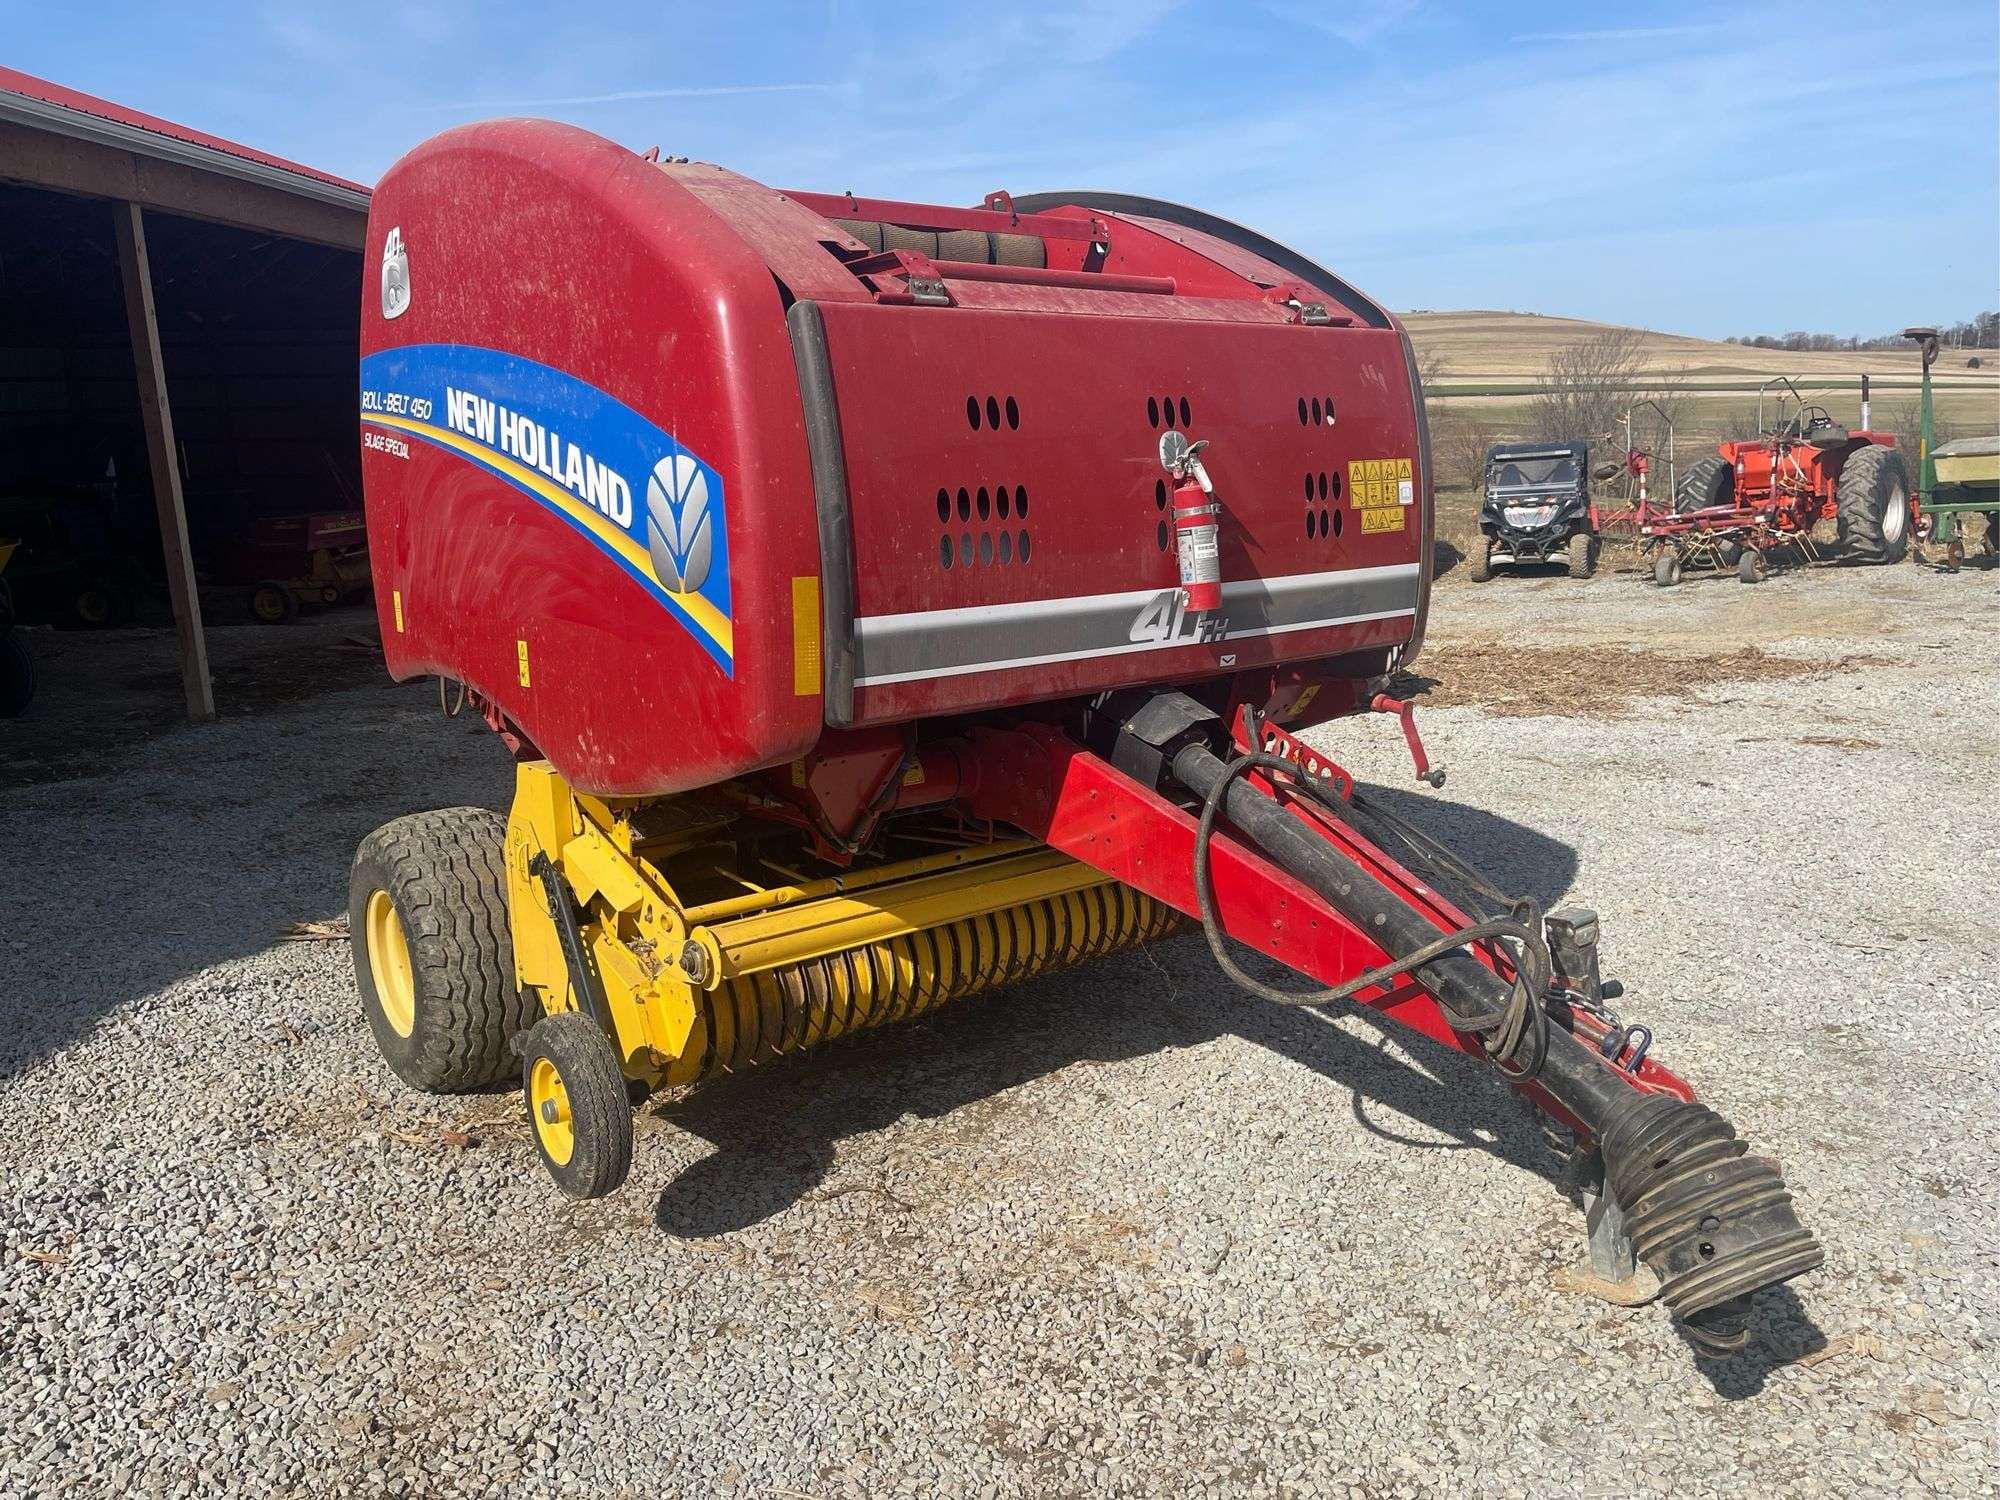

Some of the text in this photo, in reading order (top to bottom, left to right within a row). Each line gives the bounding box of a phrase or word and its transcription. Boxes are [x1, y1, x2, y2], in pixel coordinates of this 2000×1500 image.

[362, 390, 433, 421] ROLL-BELT 450
[384, 437, 410, 460] SPECIAL
[446, 386, 633, 530] NEW HOLLAND
